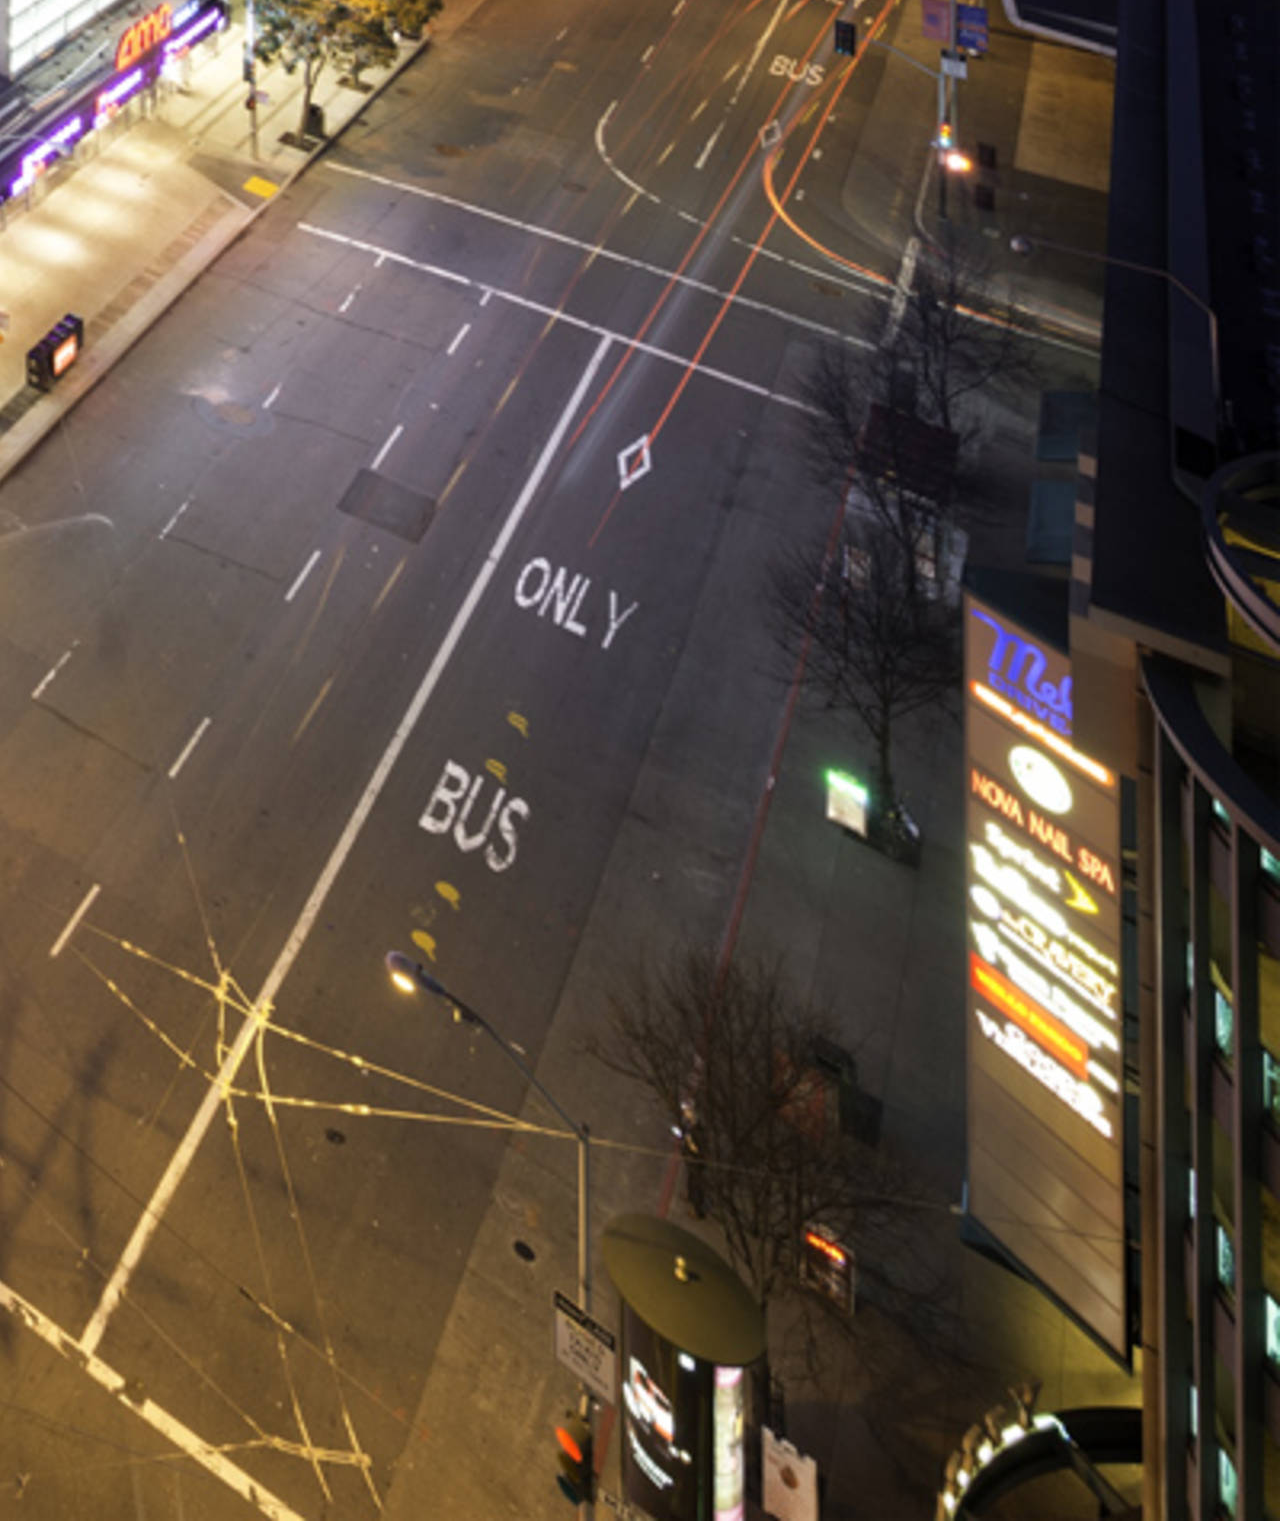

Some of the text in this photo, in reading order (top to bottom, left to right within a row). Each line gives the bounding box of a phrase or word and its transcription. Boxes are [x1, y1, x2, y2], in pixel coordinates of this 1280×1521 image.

[769, 54, 826, 86] BUS
[514, 556, 639, 649] ONLY
[418, 758, 532, 873] BUS
[971, 767, 1116, 895] NOVA NAIL SPA
